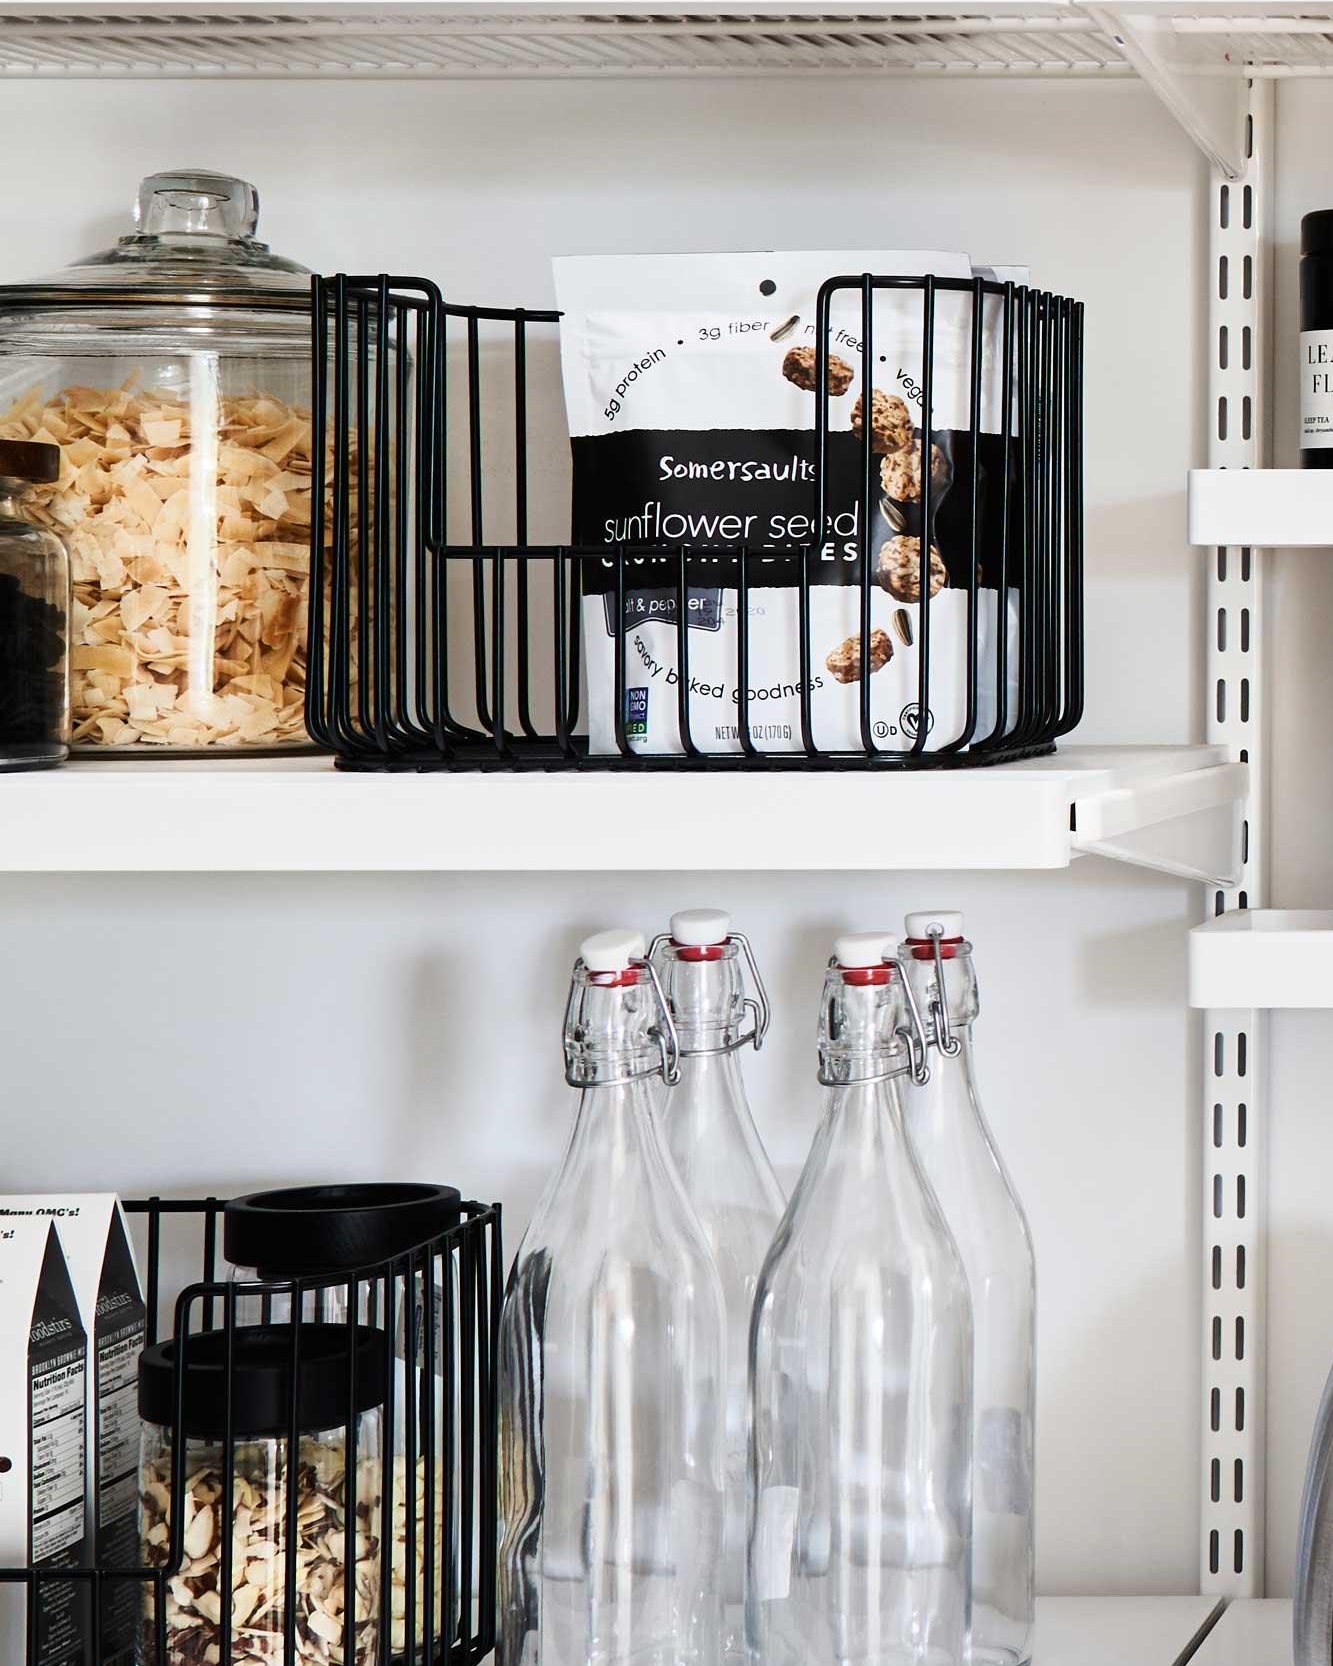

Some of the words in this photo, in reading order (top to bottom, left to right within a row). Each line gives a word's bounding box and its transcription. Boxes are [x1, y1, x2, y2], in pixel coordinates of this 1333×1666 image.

[699, 327, 721, 341] 3g
[729, 320, 769, 333] fiber
[604, 398, 621, 421] 5g
[615, 348, 666, 397] protein
[604, 501, 758, 543] sunflower
[636, 599, 645, 612] &
[634, 635, 663, 677] savory
[100, 1342, 127, 1362] Nutrition
[32, 1358, 57, 1376] BROOKLYN
[33, 1369, 65, 1390] Nutrition
[67, 1362, 84, 1377] Facts
